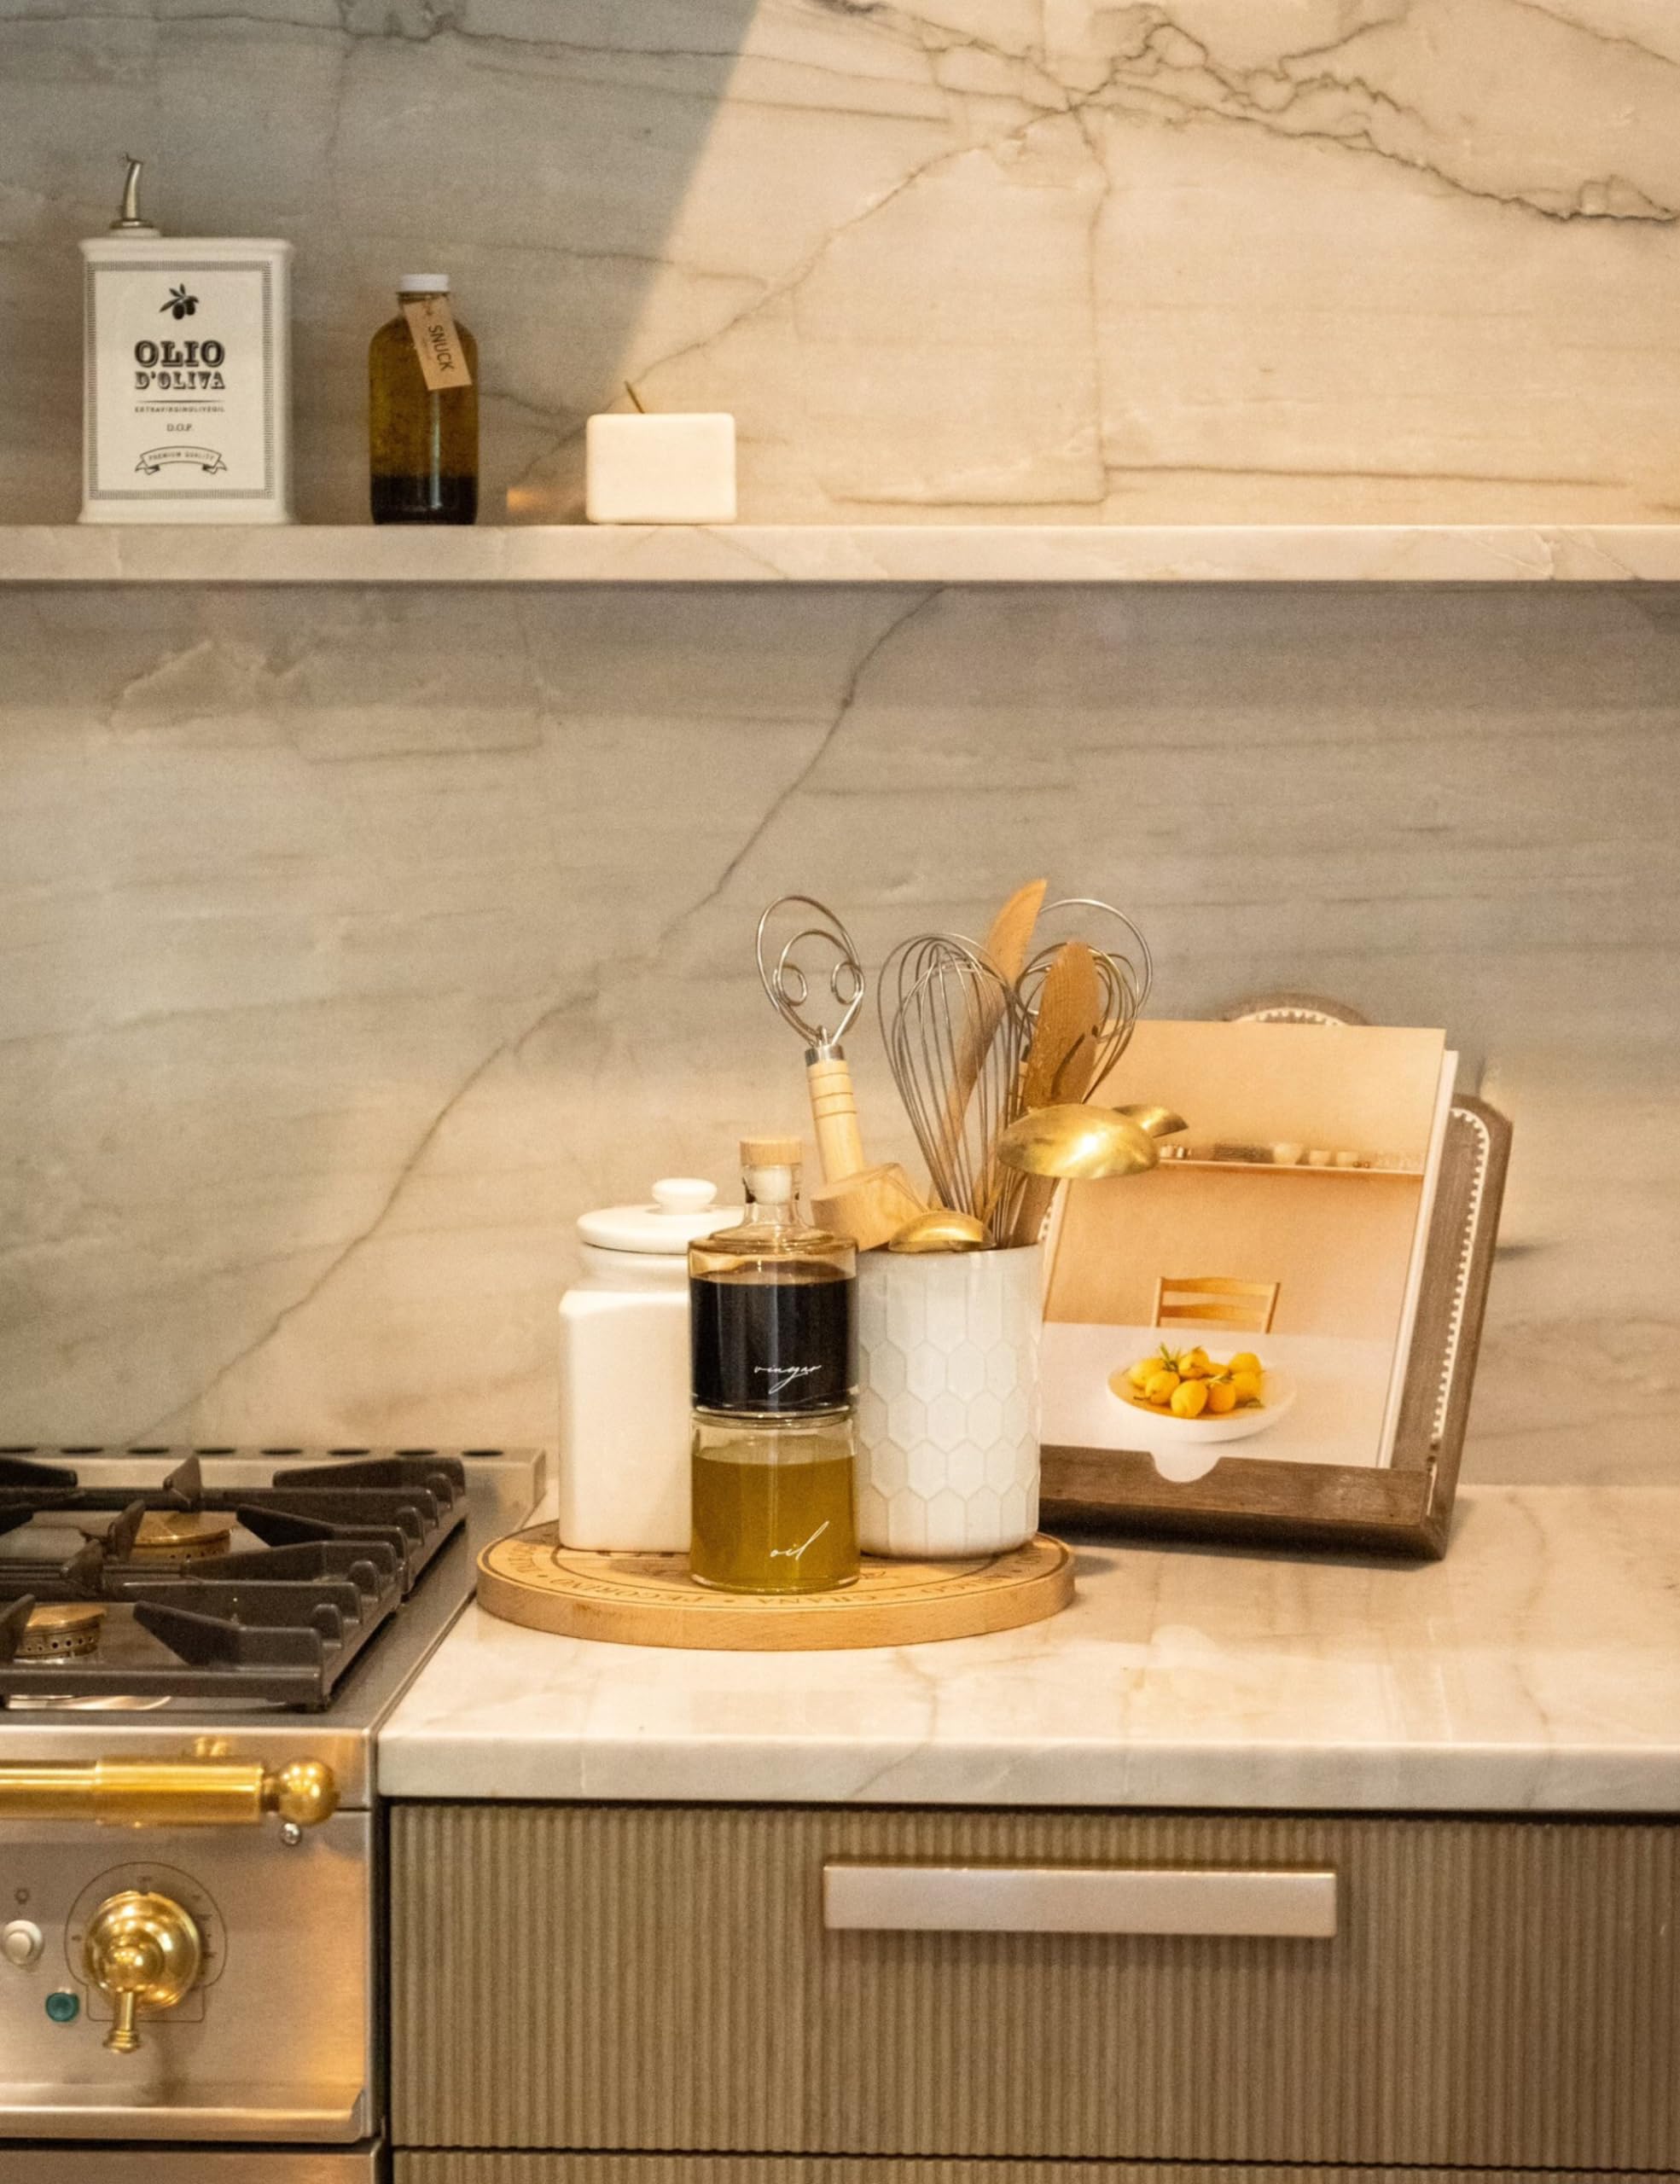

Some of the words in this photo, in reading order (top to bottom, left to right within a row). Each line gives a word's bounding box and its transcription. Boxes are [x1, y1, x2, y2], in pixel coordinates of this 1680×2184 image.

[135, 340, 224, 368] OLIO
[428, 324, 454, 371] SNUCK
[135, 371, 225, 389] D'OLIVA
[770, 1520, 829, 1561] oil
